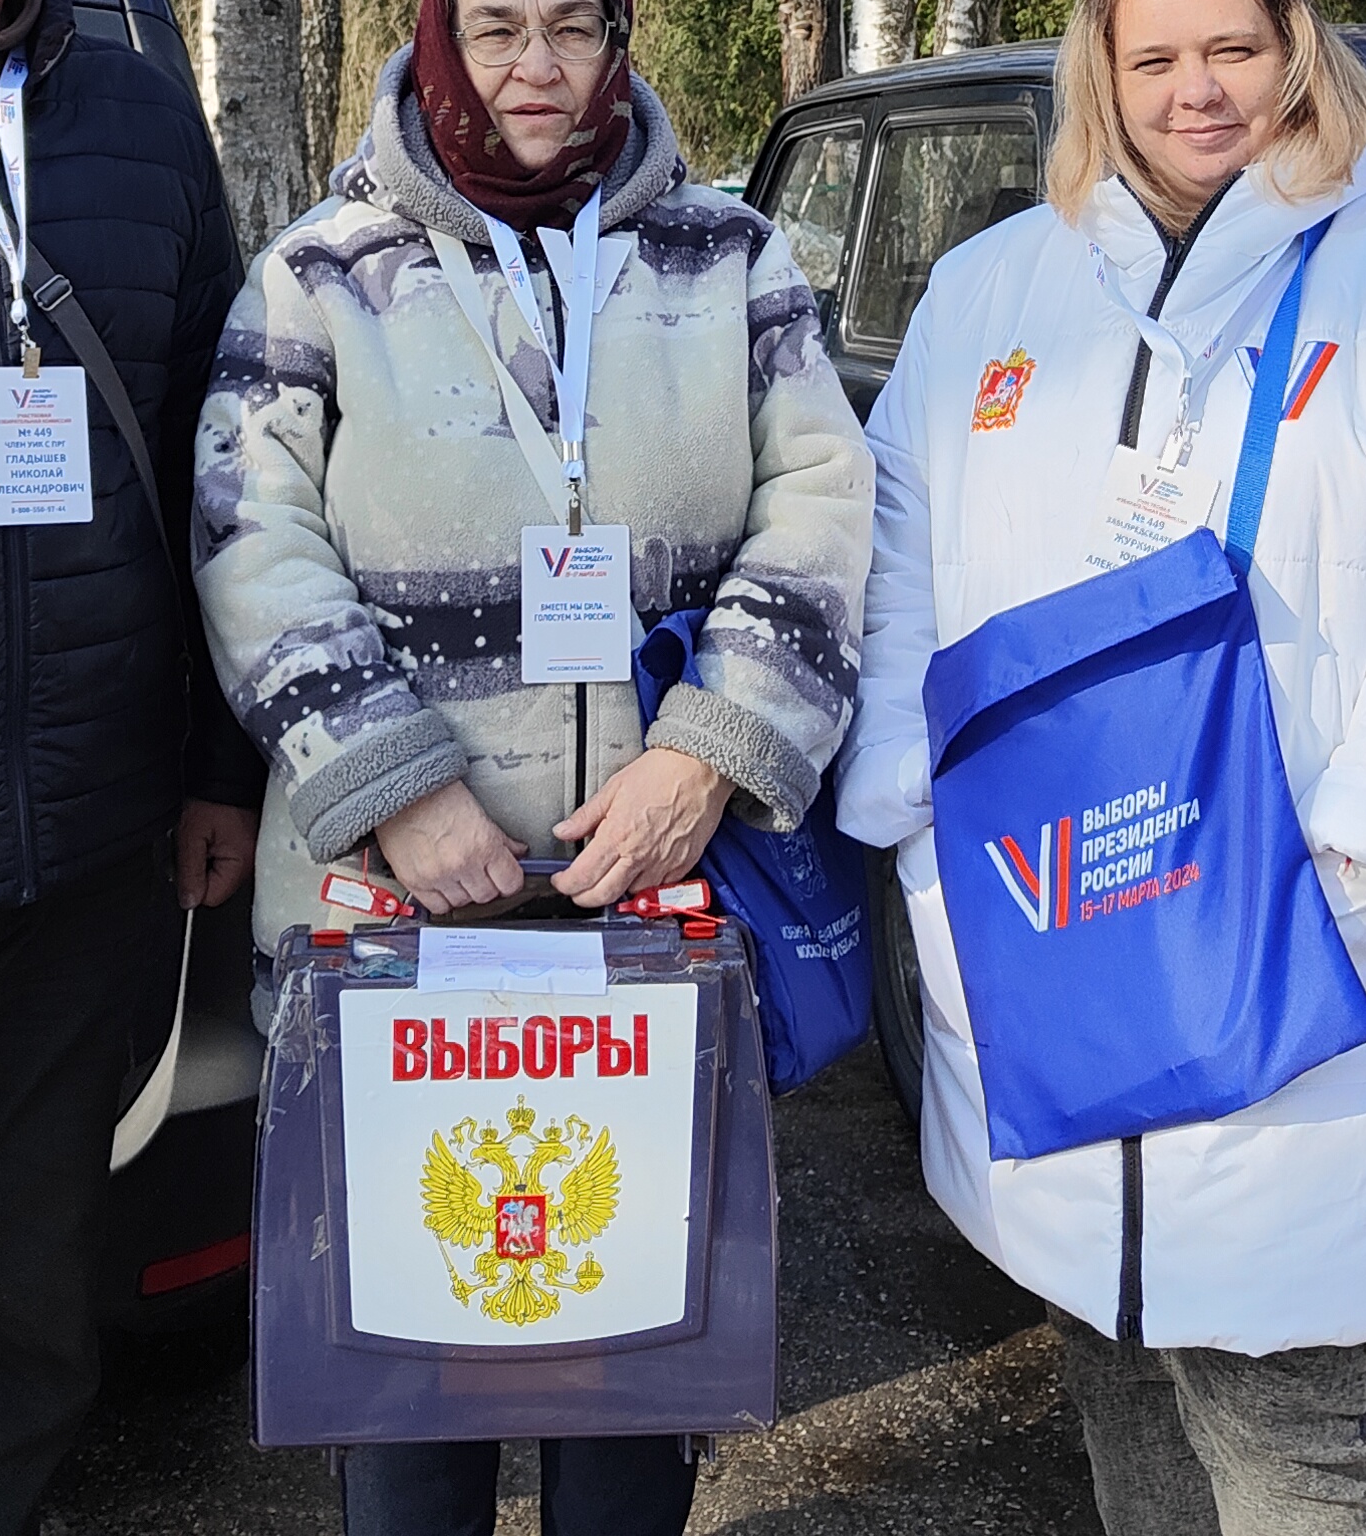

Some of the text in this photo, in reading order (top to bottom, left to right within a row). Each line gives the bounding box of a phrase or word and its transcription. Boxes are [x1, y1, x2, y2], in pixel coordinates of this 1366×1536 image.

[34, 427, 52, 437] 449
[4, 441, 26, 449] ЧЛЕН
[5, 453, 66, 465] ГЛАДЫШЕВ
[10, 467, 63, 479] НИКОЛАЙ
[540, 603, 568, 611] ВМЕСТЕ
[569, 603, 583, 611] МЫ
[584, 602, 603, 611] СИЛА
[534, 613, 571, 622] ГОЛОСУЕМ
[572, 612, 582, 621] ЗА
[1082, 780, 1167, 834] ВЫБОРЫ
[1081, 797, 1201, 865] ПРЕЗИДЕНТА
[1080, 848, 1154, 896] РОССИИ
[1117, 876, 1161, 912] МАРТА
[1163, 860, 1201, 894] 2024
[392, 1013, 649, 1082] ВЫБОРЫ
